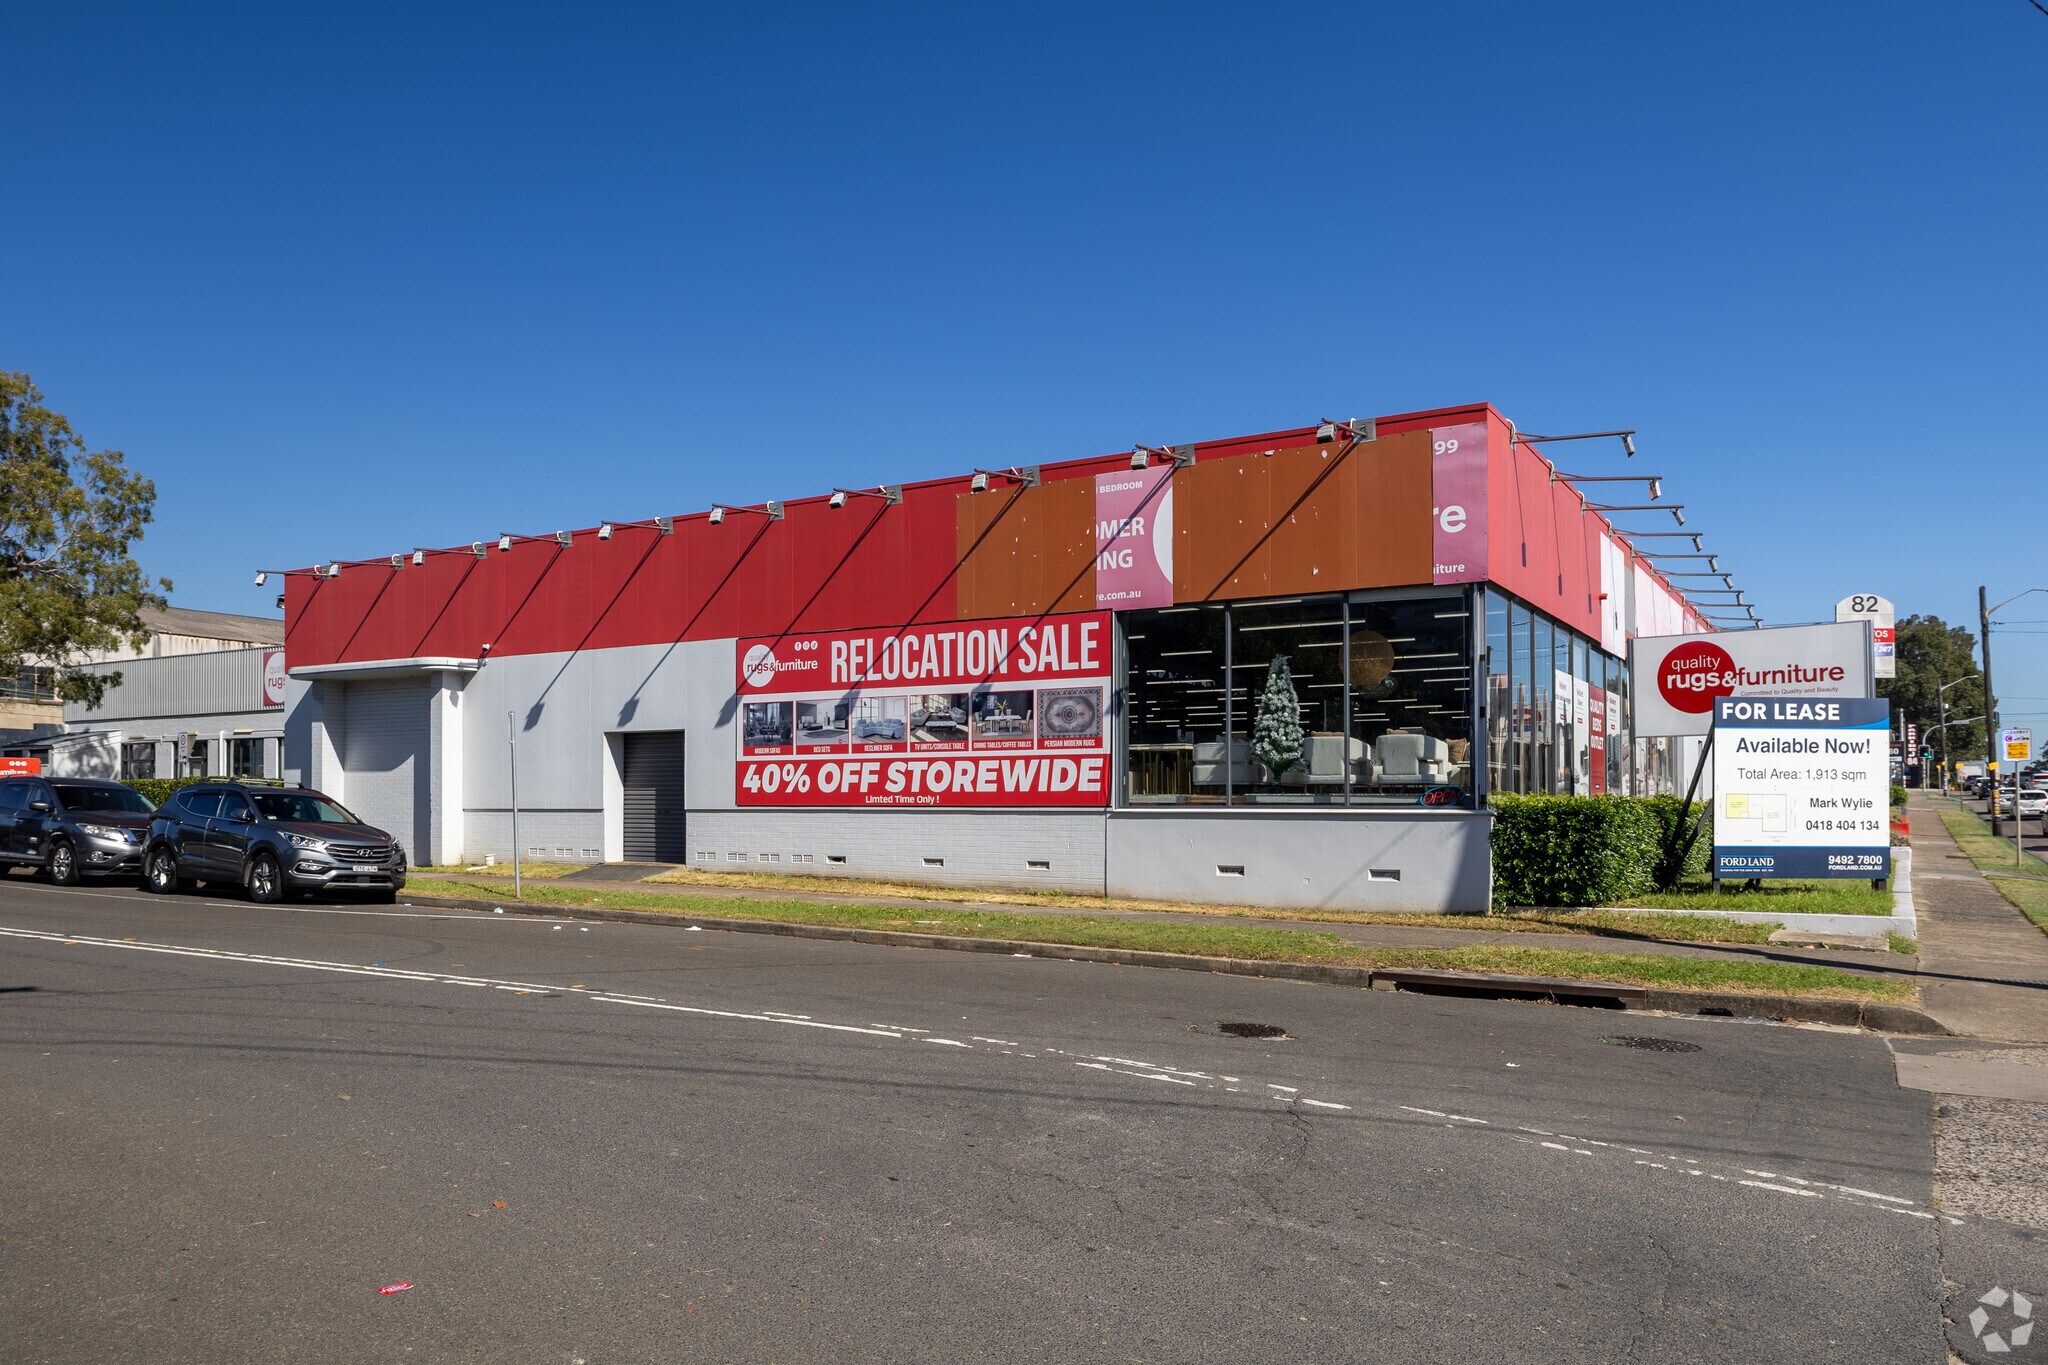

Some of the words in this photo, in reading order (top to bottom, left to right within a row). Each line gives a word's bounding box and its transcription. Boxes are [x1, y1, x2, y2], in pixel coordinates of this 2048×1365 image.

[1100, 481, 1143, 493] BEDROOM
[1433, 505, 1467, 533] e
[1096, 517, 1145, 540] MER
[1852, 596, 1878, 613] 82
[749, 653, 769, 662] quality
[831, 628, 1008, 683] RELOCATION
[1018, 622, 1099, 673] SALE
[747, 659, 818, 674] rugs&furniture
[1671, 655, 1721, 672] quality
[1740, 689, 1772, 697] Committed
[1781, 688, 1803, 696] Quality
[1817, 686, 1839, 694] Beauty
[1590, 698, 1604, 715] QUALITY
[1722, 702, 1767, 720] FOR
[1774, 703, 1840, 721] LEASE
[1017, 740, 1032, 748] TABLES
[1064, 739, 1082, 747] MODERN
[1736, 737, 1820, 754] Available
[1825, 738, 1871, 754] Now!
[742, 763, 811, 793] 40%
[817, 762, 881, 793] OFF
[884, 758, 1104, 793] STOREWIDE
[1737, 767, 1767, 780] Total
[1770, 768, 1801, 780] Area:
[1806, 769, 1838, 782] 1,913
[1841, 771, 1867, 782] sqm
[894, 795, 915, 803] Time
[917, 796, 935, 804] Only
[1809, 798, 1838, 808] Mark
[1841, 797, 1873, 811] Wylie
[1805, 820, 1833, 831] 0418
[1836, 820, 1857, 831] 404
[1860, 820, 1880, 831] 134
[1720, 857, 1747, 866] FORD
[1748, 857, 1775, 866] LAND
[1828, 856, 1854, 865] 9492
[1857, 856, 1883, 865] 7800
